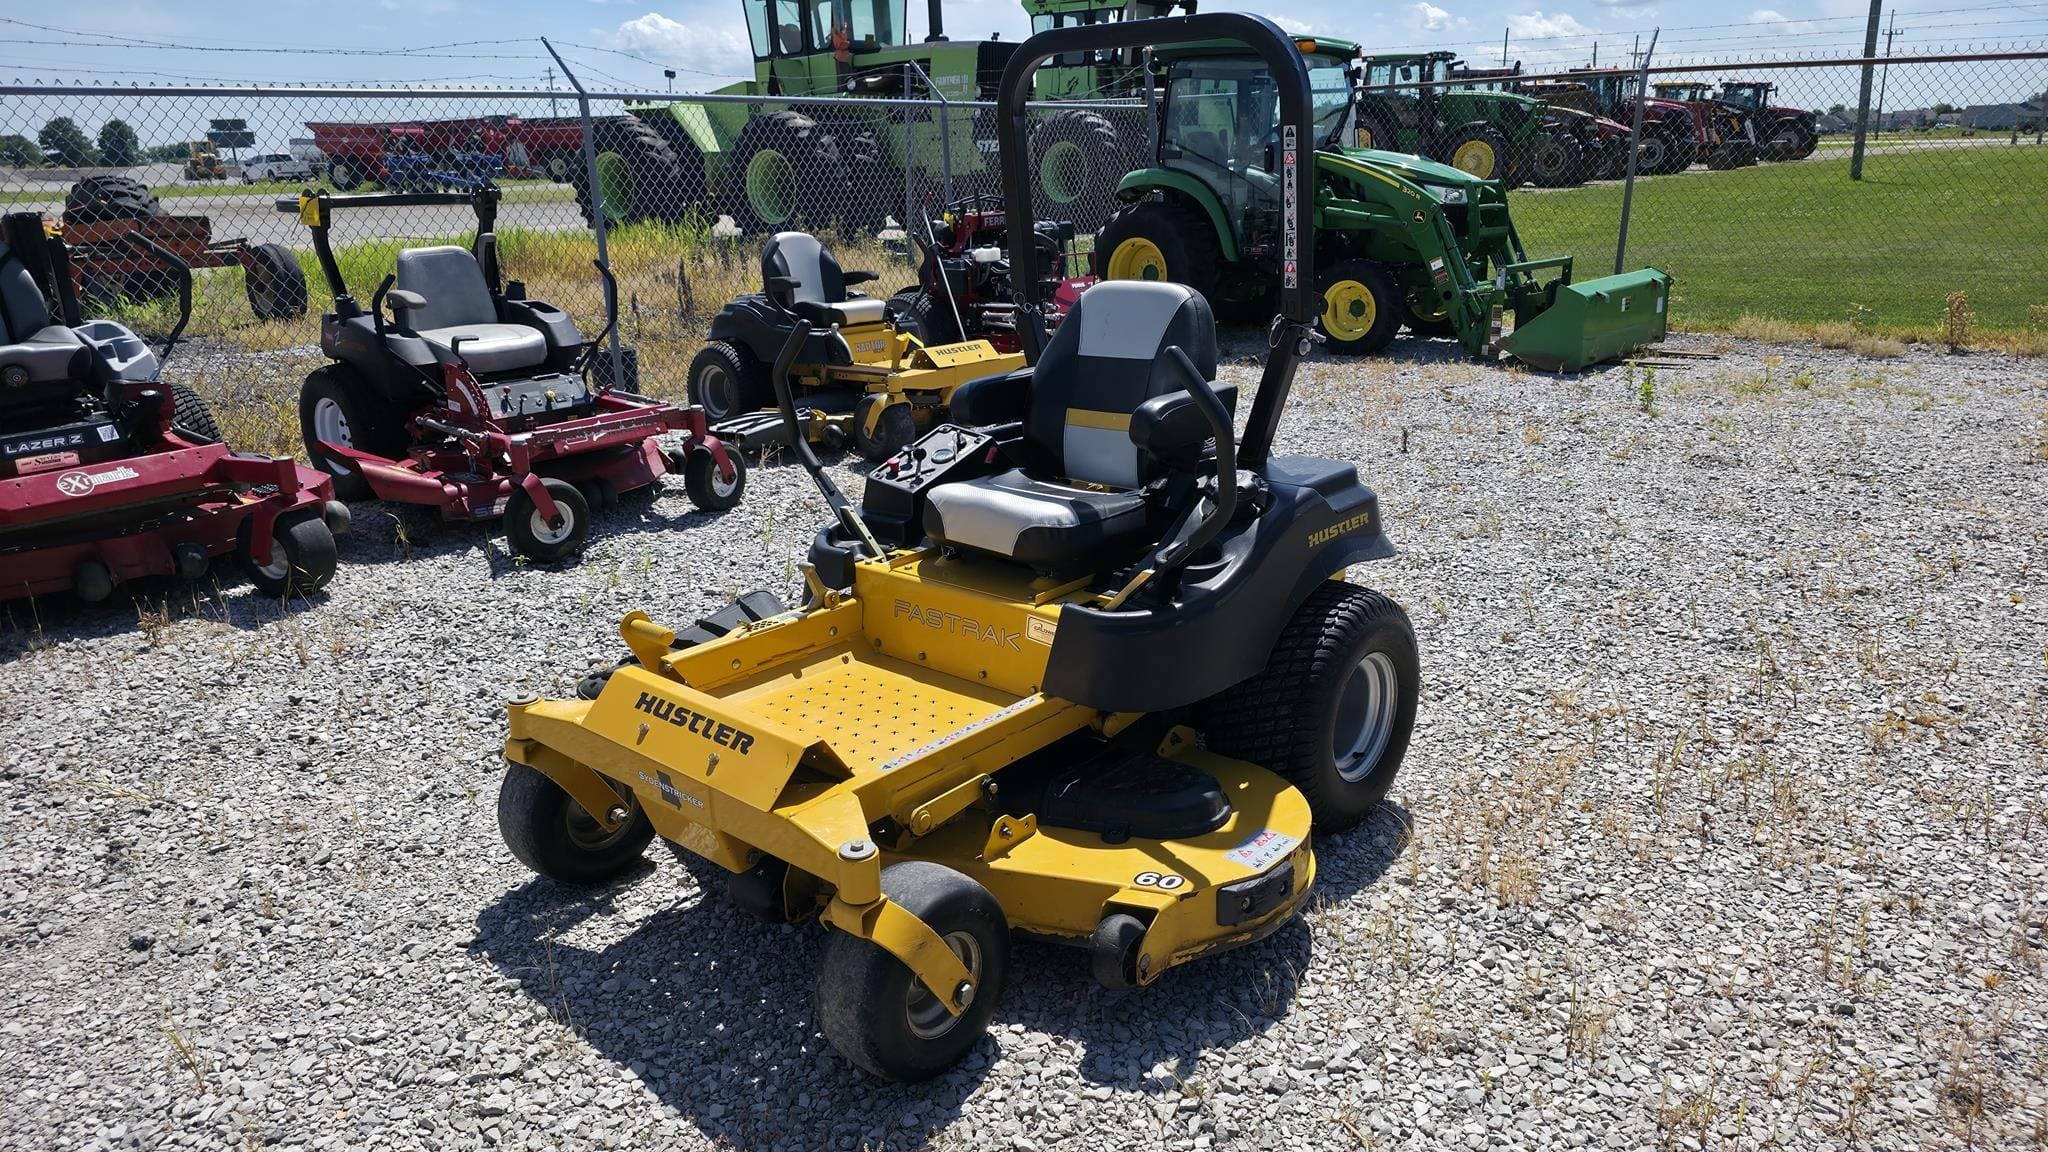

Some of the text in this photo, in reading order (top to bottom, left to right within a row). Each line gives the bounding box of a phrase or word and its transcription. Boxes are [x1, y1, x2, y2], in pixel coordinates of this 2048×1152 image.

[976, 140, 1000, 152] STE
[935, 344, 982, 356] HUSTLER
[6, 435, 83, 454] LAZER Z
[1308, 512, 1369, 548] HUSTLER
[894, 599, 1021, 652] FASTRAK
[634, 691, 755, 755] HUSTLER
[638, 771, 704, 808] SYDENSTRICKER
[1134, 871, 1185, 889] 60
